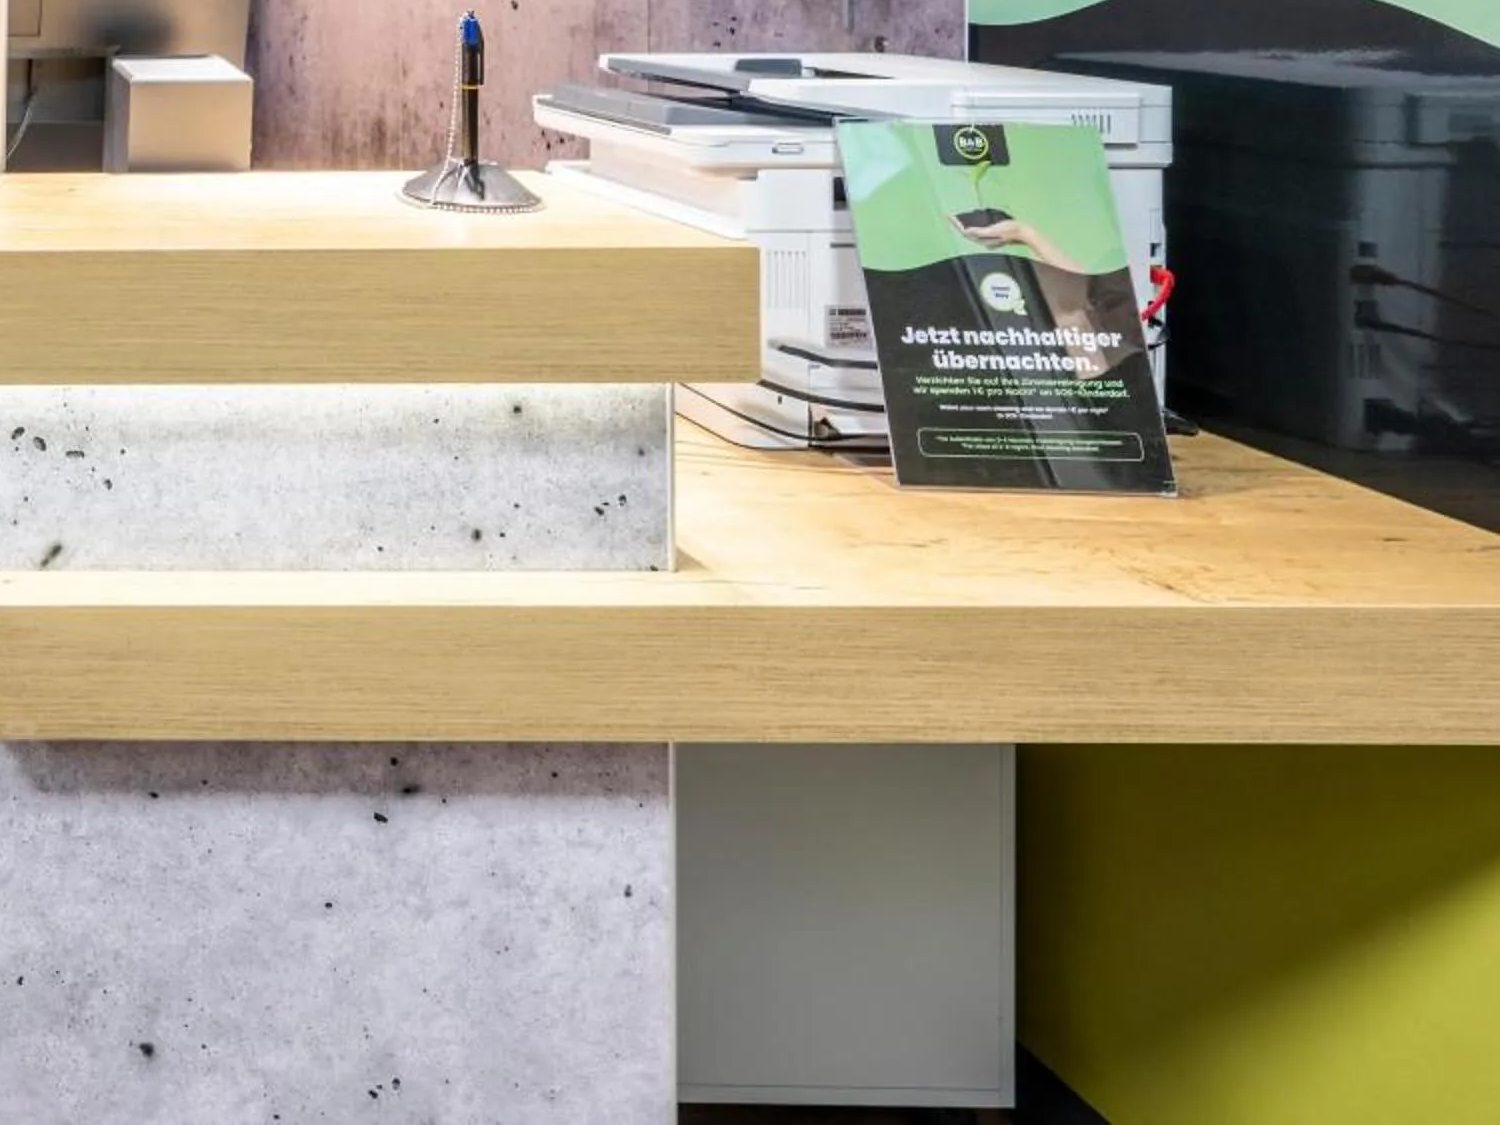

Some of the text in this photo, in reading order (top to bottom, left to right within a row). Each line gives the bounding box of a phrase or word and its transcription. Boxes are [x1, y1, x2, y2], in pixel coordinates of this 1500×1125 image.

[901, 327, 1123, 352] Jetzt nachhaltiger
[932, 349, 1099, 371] übernachten.
